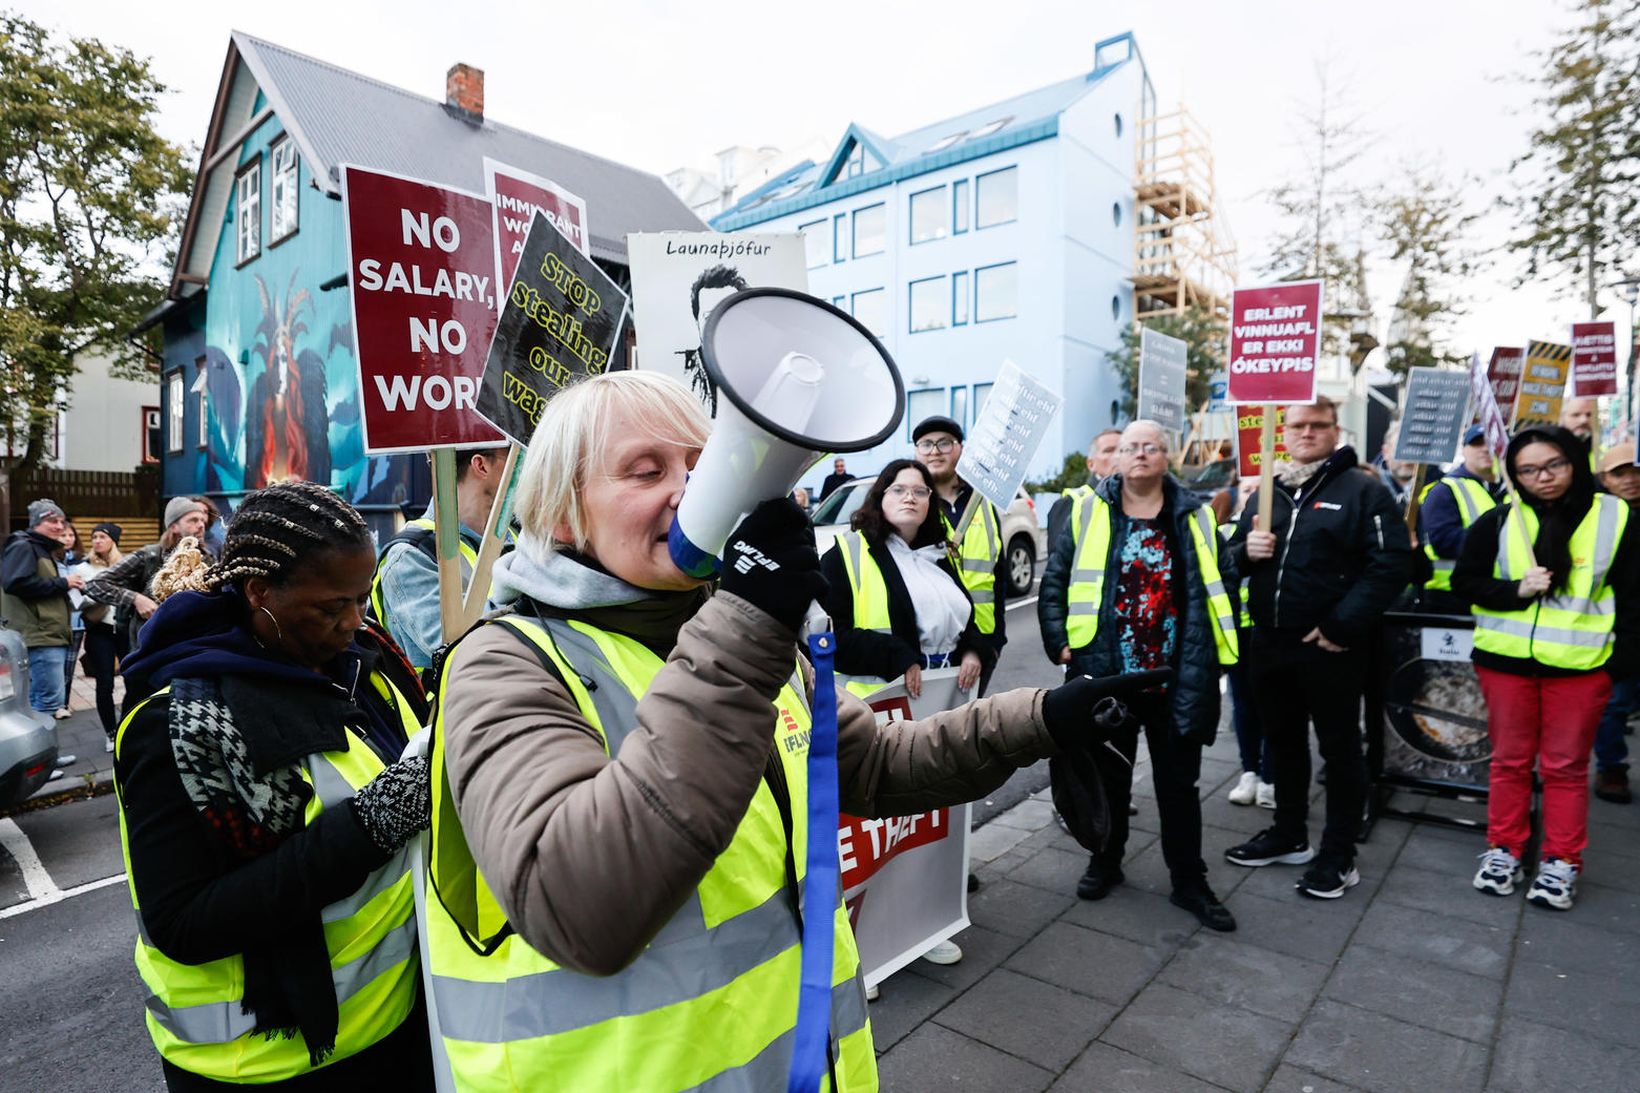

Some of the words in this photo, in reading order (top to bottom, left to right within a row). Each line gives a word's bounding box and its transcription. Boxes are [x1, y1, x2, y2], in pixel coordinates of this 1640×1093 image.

[401, 208, 460, 253] NO
[496, 193, 581, 239] IMMIRANT
[666, 239, 771, 260] Launaþjófur
[359, 258, 494, 310] SALARY,
[540, 252, 602, 317] STOP
[511, 280, 608, 377] stealing
[1233, 321, 1316, 339] VINNUAFL
[1243, 304, 1307, 322] ERLENT
[409, 317, 467, 355] NO
[1242, 341, 1264, 355] ER
[1266, 338, 1304, 355] EKKI
[529, 346, 572, 390] our
[1231, 356, 1313, 375] ÓKEYPIS
[503, 370, 549, 427] wag
[733, 540, 781, 571] EFLING
